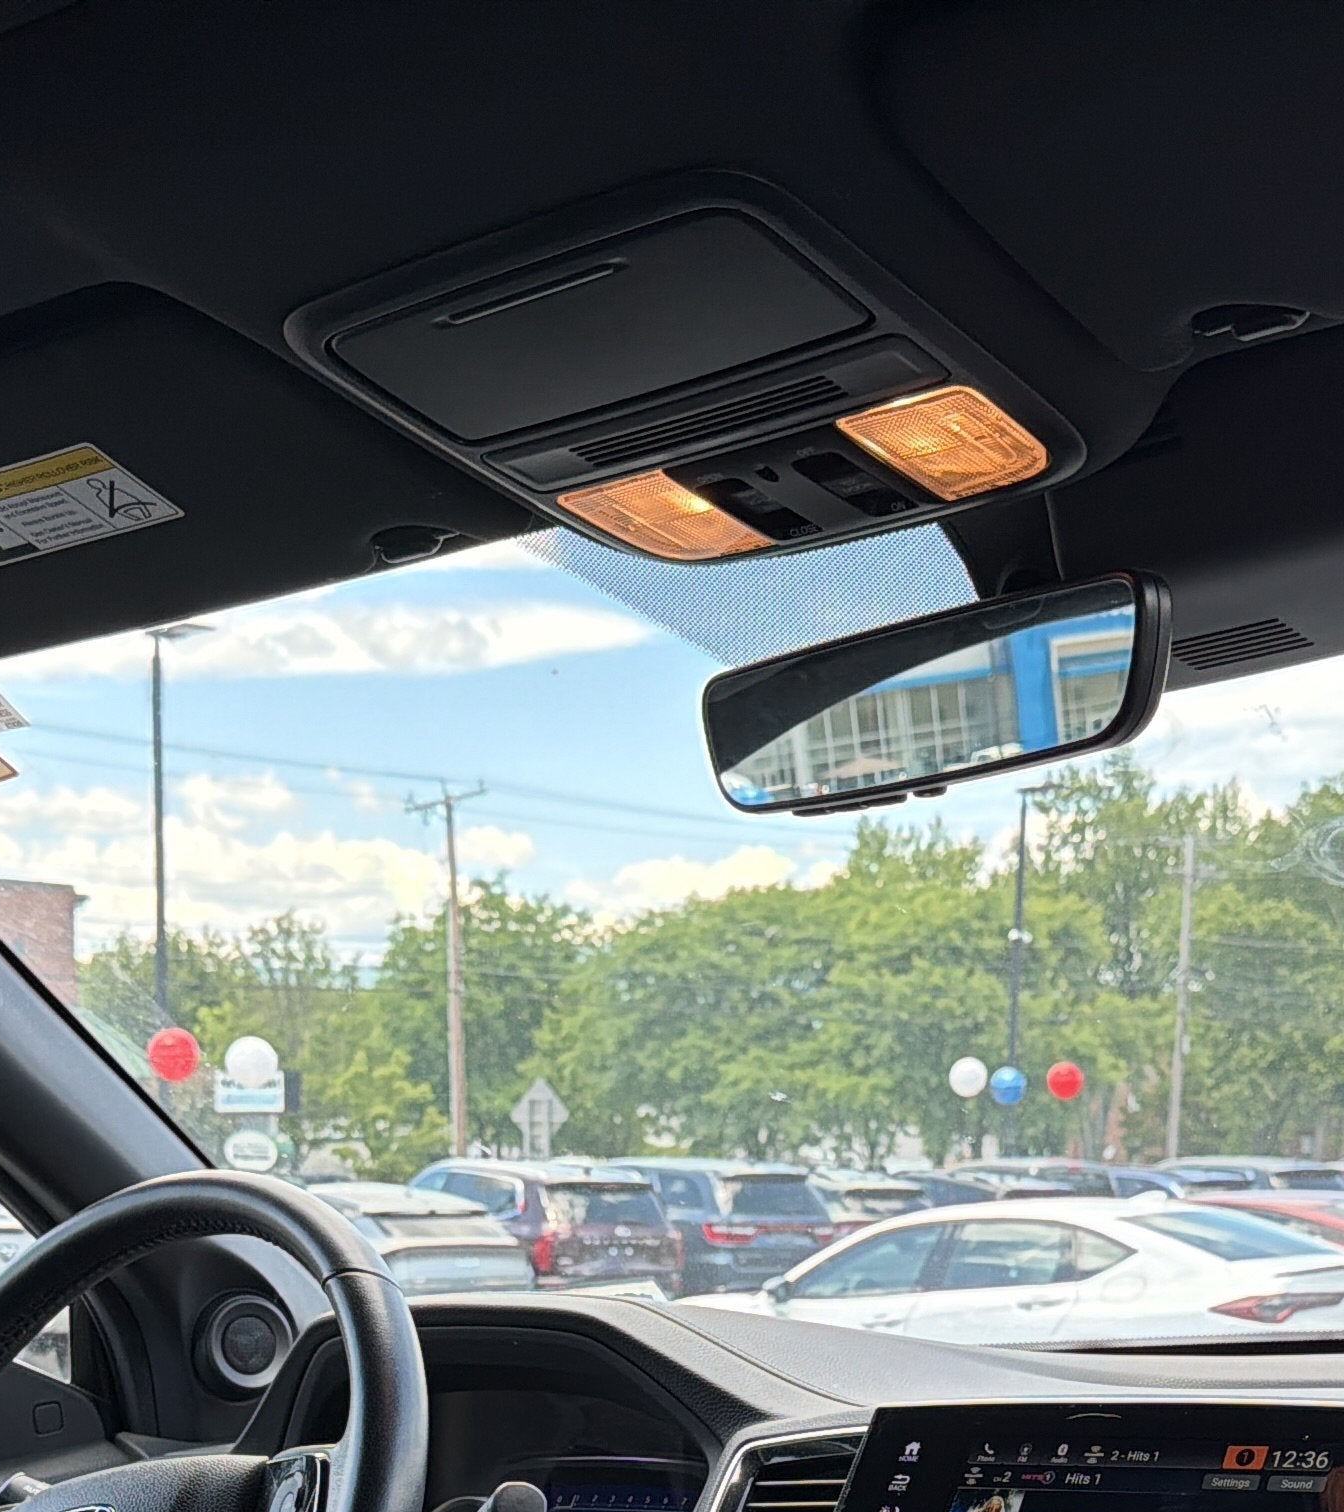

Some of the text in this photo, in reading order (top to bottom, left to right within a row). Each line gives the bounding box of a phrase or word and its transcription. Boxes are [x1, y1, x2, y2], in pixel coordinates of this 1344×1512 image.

[1272, 1450, 1330, 1469] 12:36
[1065, 1473, 1102, 1486] Hits 1
[1210, 1478, 1251, 1490] Settings
[1280, 1479, 1314, 1490] Sound
